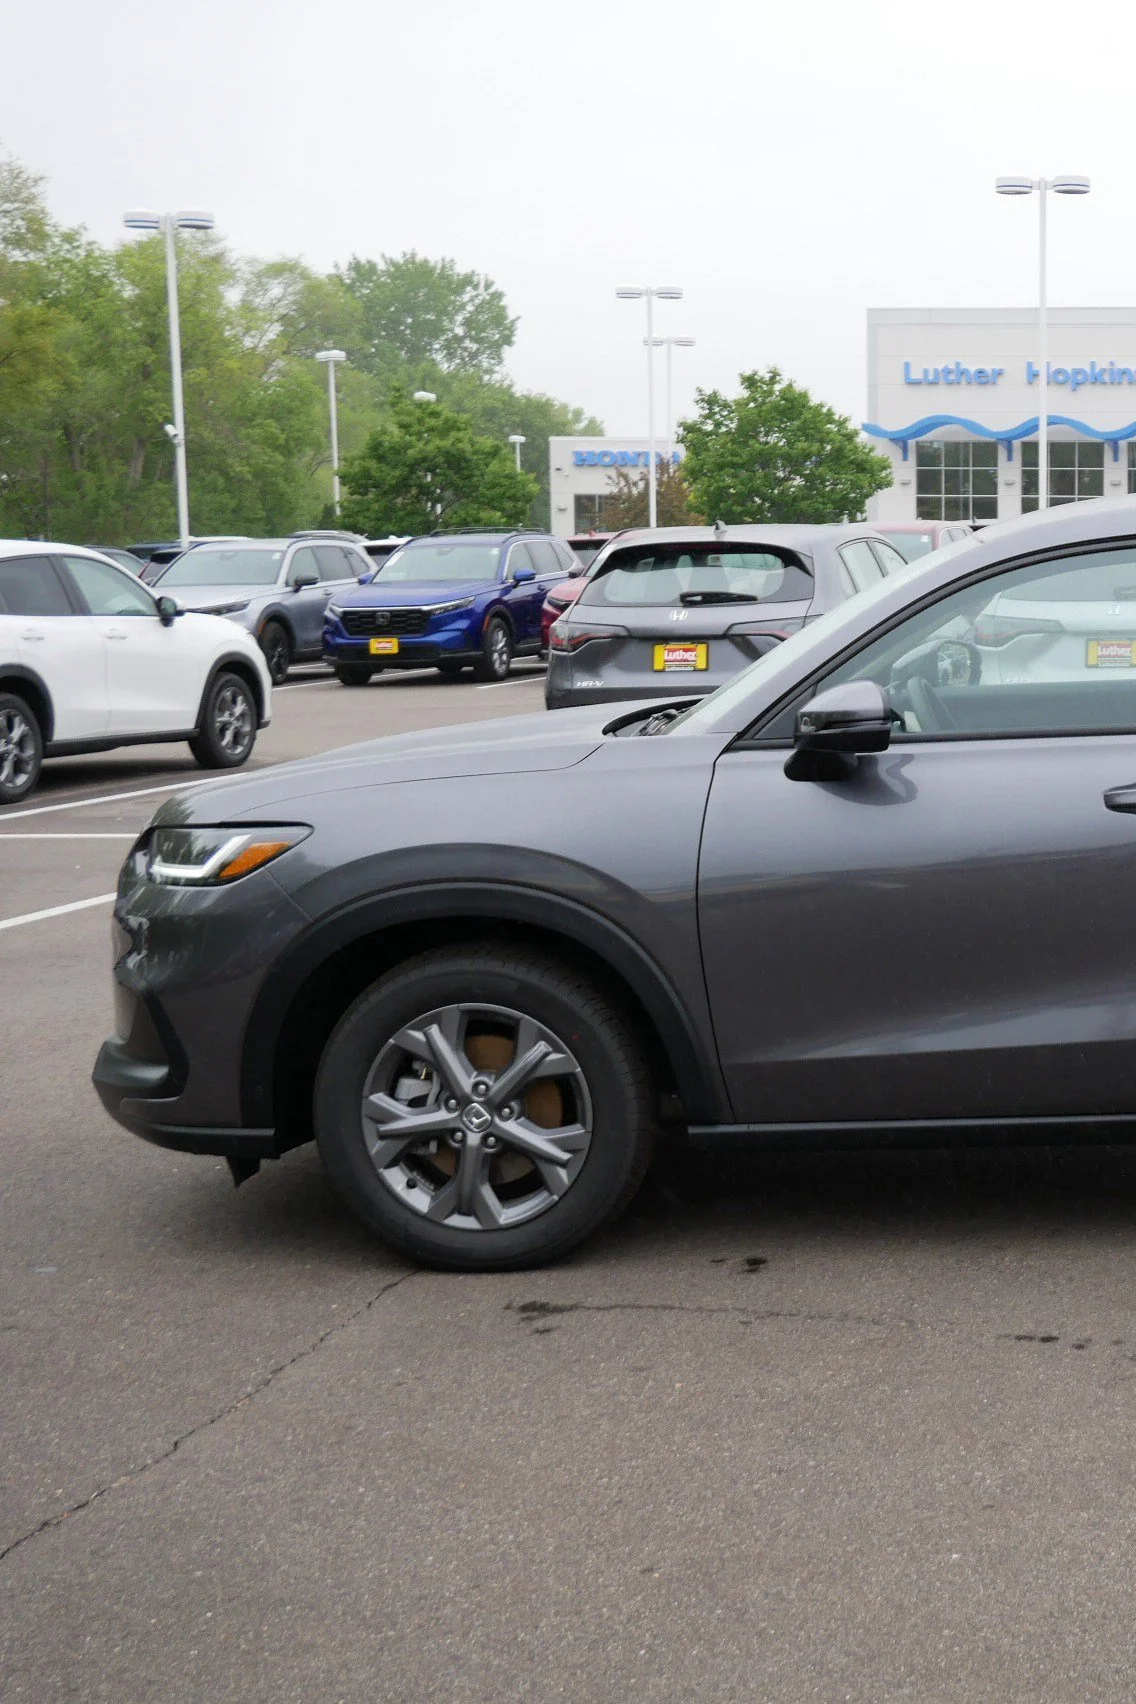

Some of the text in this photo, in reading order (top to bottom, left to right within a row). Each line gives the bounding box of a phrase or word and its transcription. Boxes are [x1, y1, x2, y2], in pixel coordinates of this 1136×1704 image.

[903, 360, 1005, 384] Luther
[664, 649, 697, 660] Luther
[576, 680, 605, 688] HR-V
